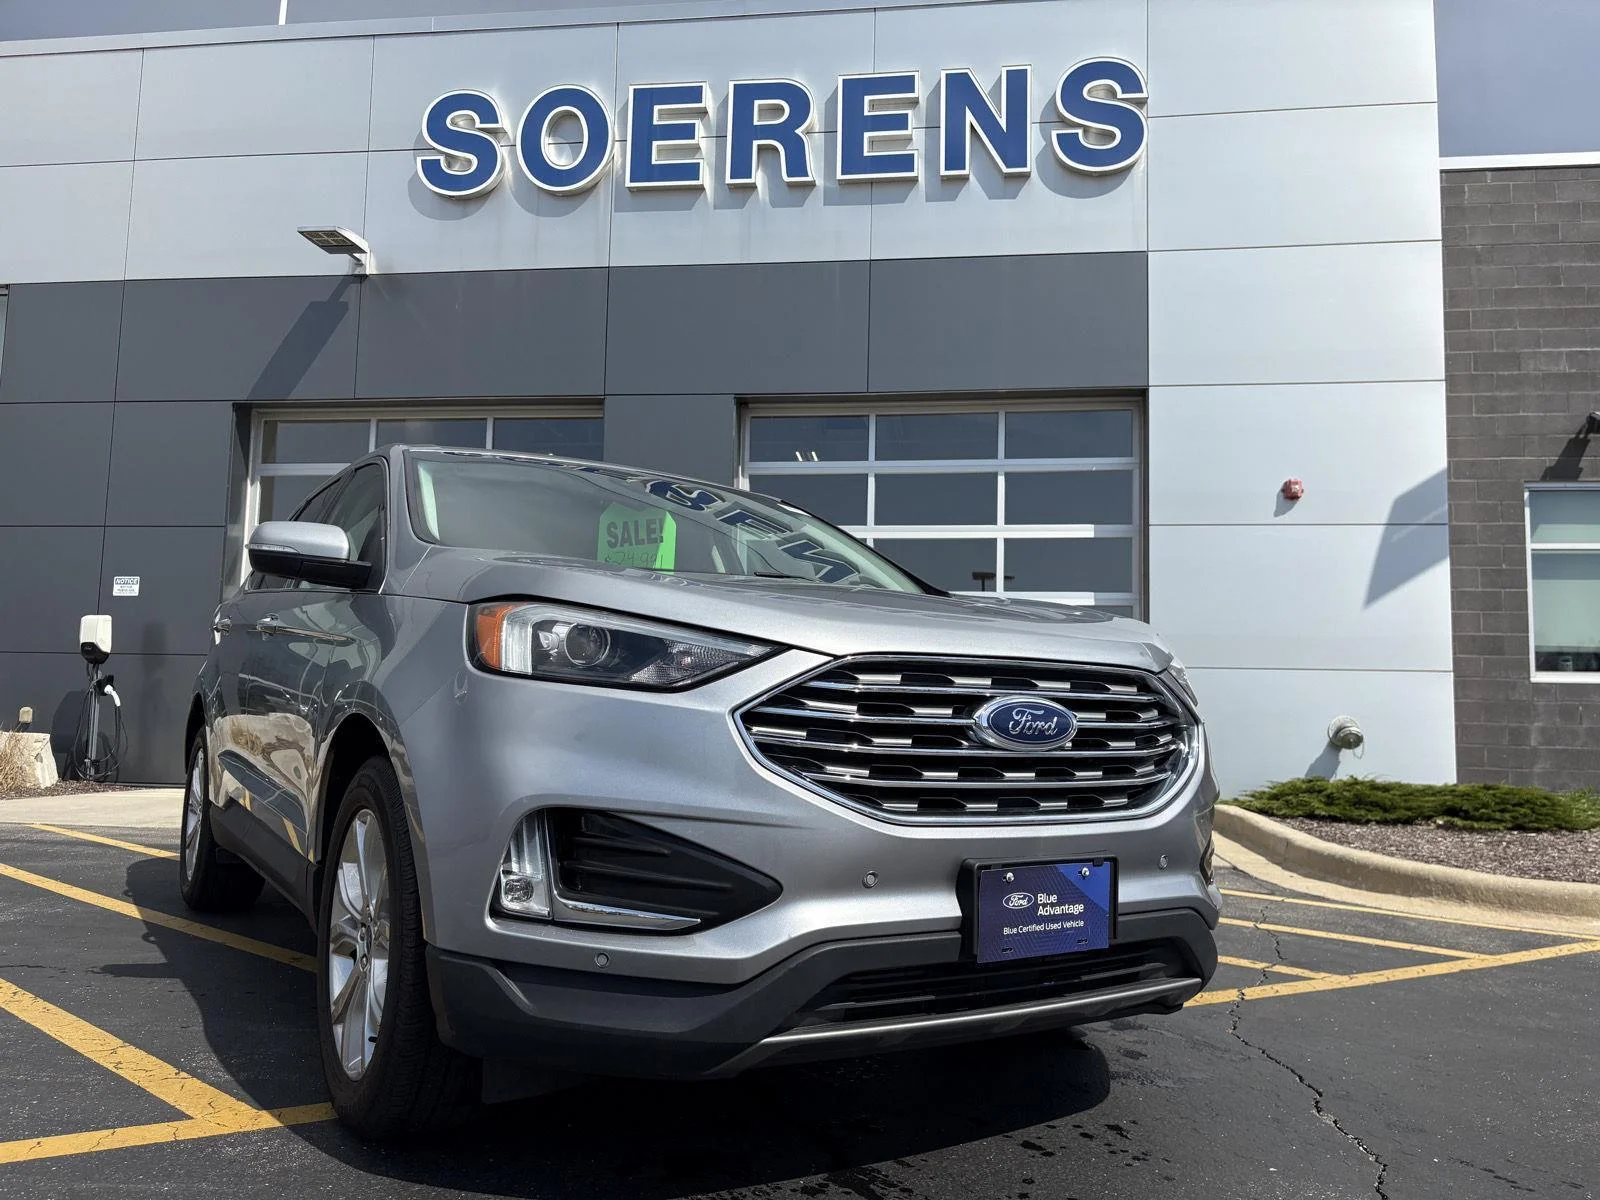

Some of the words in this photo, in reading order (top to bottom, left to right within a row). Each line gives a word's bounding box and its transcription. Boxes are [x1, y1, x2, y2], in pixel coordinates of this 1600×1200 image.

[415, 56, 1149, 199] SOERENS
[606, 518, 664, 549] SALE!
[1008, 707, 1058, 736] Ford
[1008, 894, 1029, 907] Ford
[1037, 893, 1058, 904] Blue
[1037, 903, 1085, 916] Advantage
[1003, 926, 1018, 935] Blue
[1018, 923, 1045, 933] Certified
[1046, 921, 1062, 931] Used
[1063, 919, 1085, 929] Vehicle
